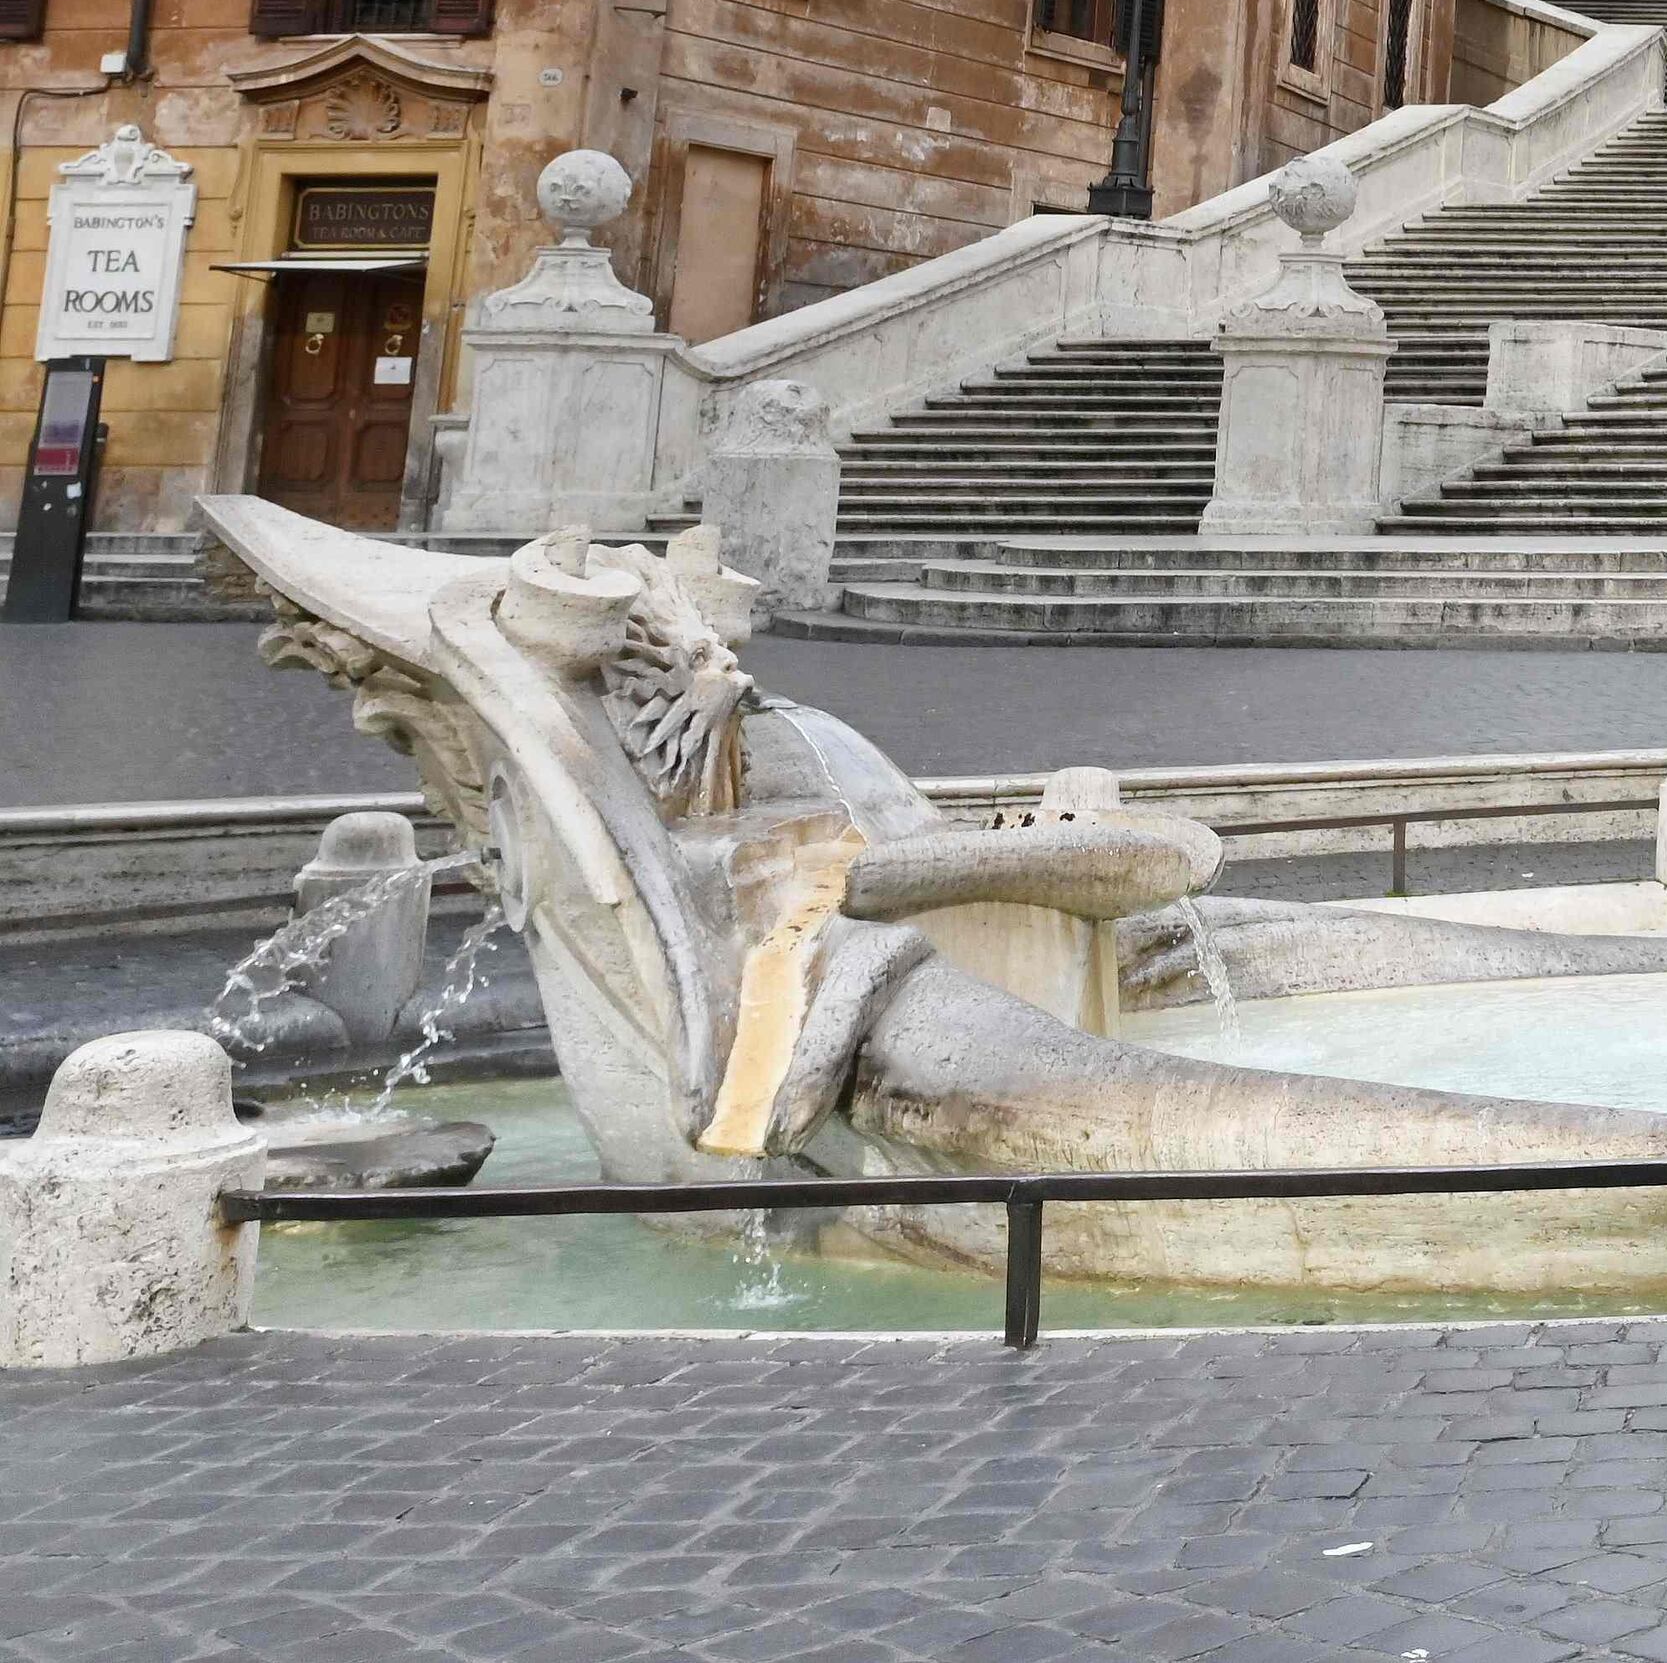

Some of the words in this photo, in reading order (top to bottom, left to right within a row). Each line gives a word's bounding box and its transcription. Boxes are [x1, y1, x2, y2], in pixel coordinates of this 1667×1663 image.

[73, 214, 165, 229] BABINGTON'S
[86, 249, 141, 273] TEA
[63, 289, 155, 314] ROOMS
